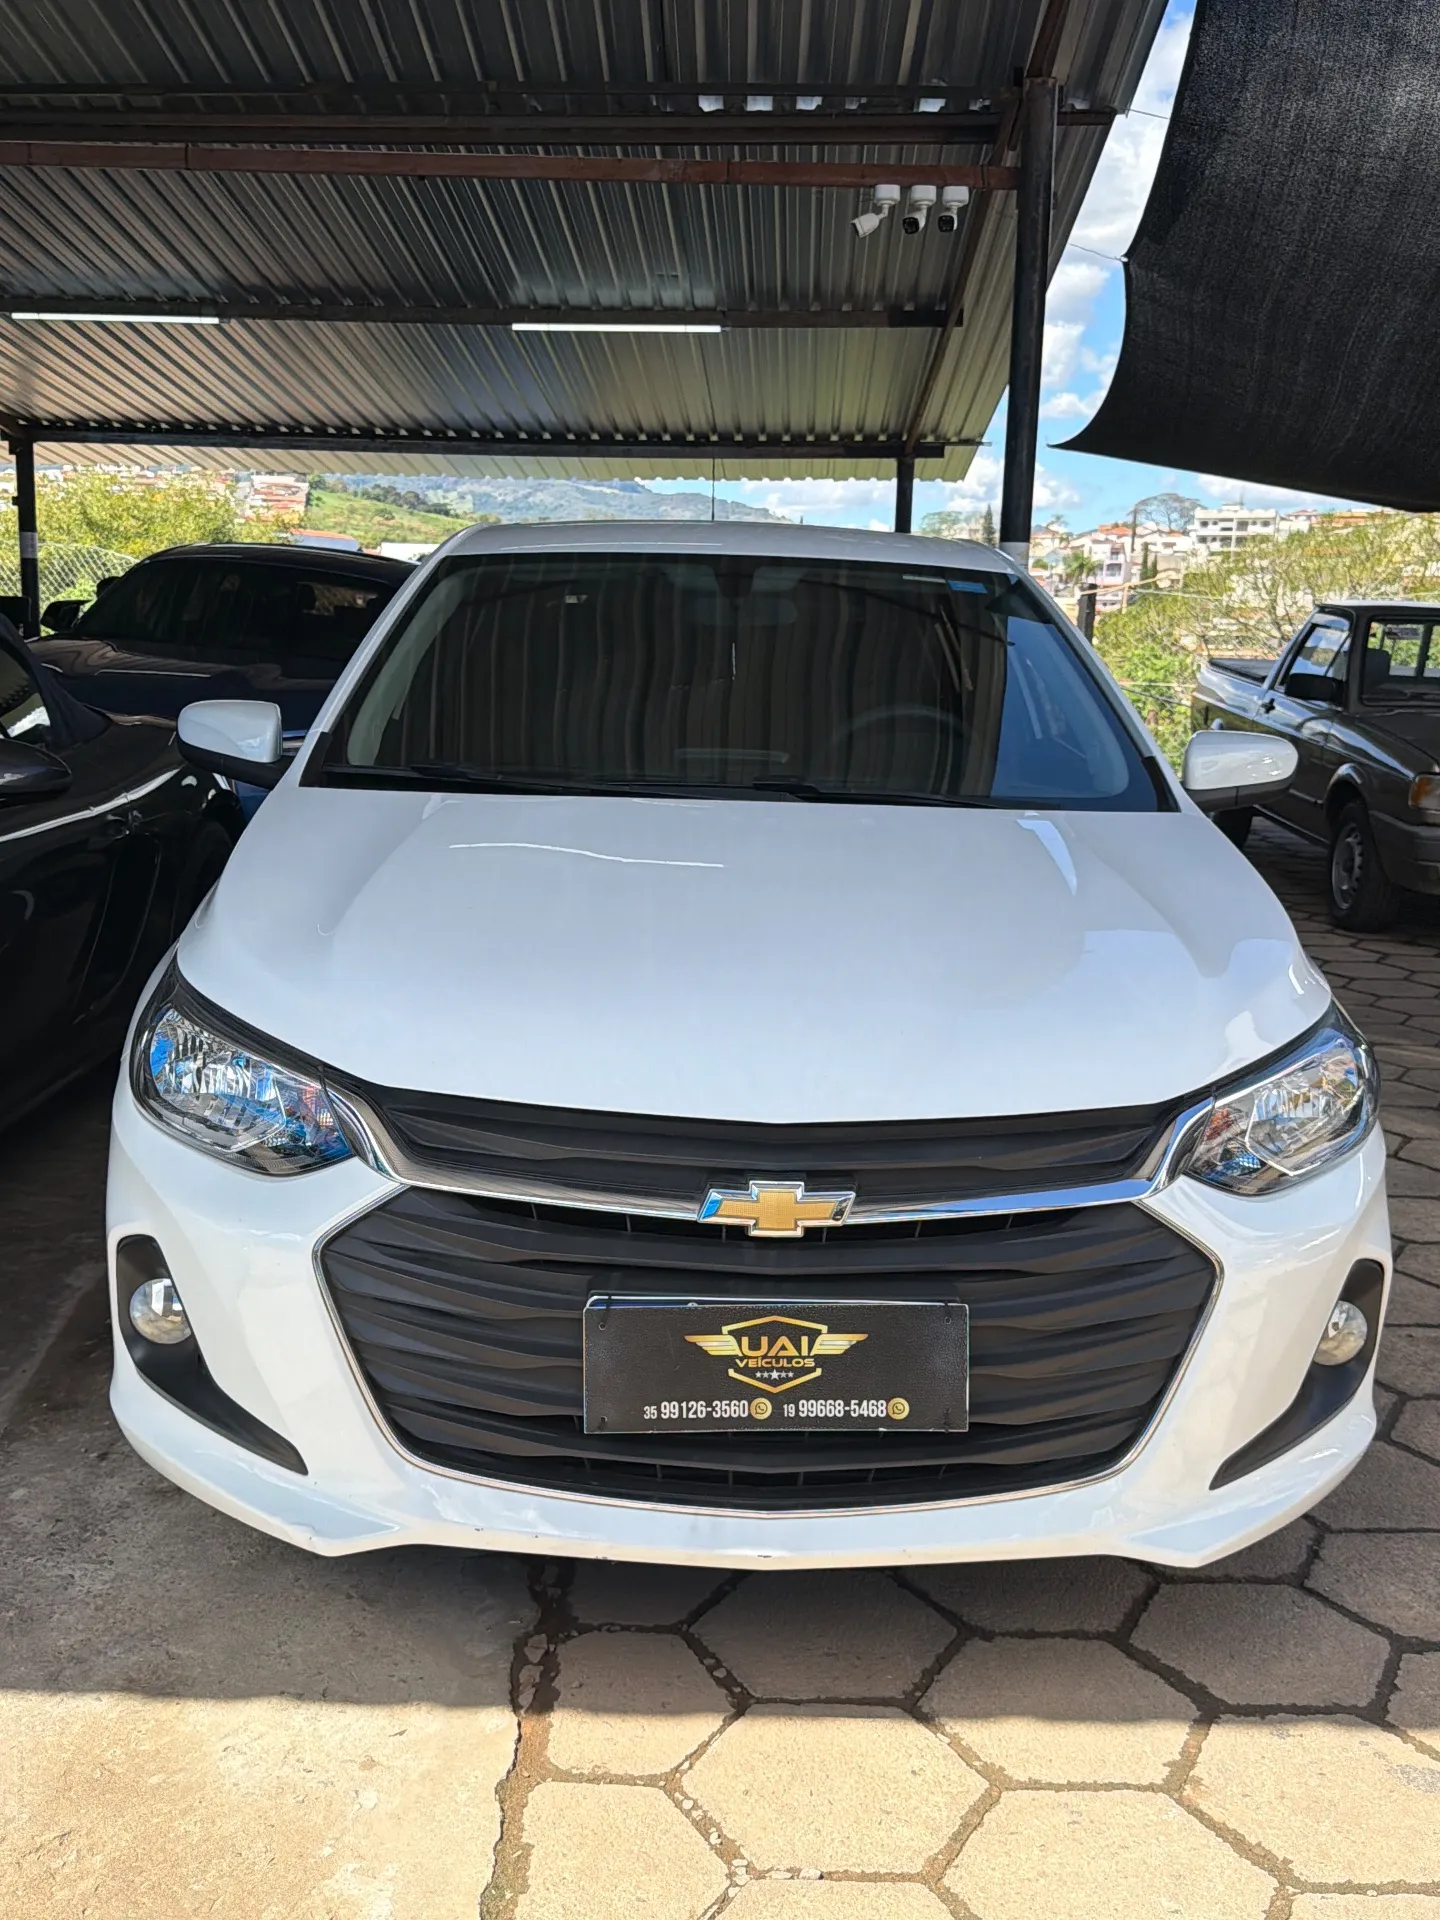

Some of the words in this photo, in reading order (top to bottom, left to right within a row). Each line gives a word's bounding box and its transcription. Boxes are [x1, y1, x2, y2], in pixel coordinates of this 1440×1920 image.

[741, 1335, 809, 1357] UAI
[735, 1357, 816, 1368] VEÍCULOS
[643, 1406, 658, 1419] 35
[660, 1400, 749, 1419] 99126-3560
[782, 1403, 796, 1418] 19
[798, 1399, 887, 1418] 99668-5468
